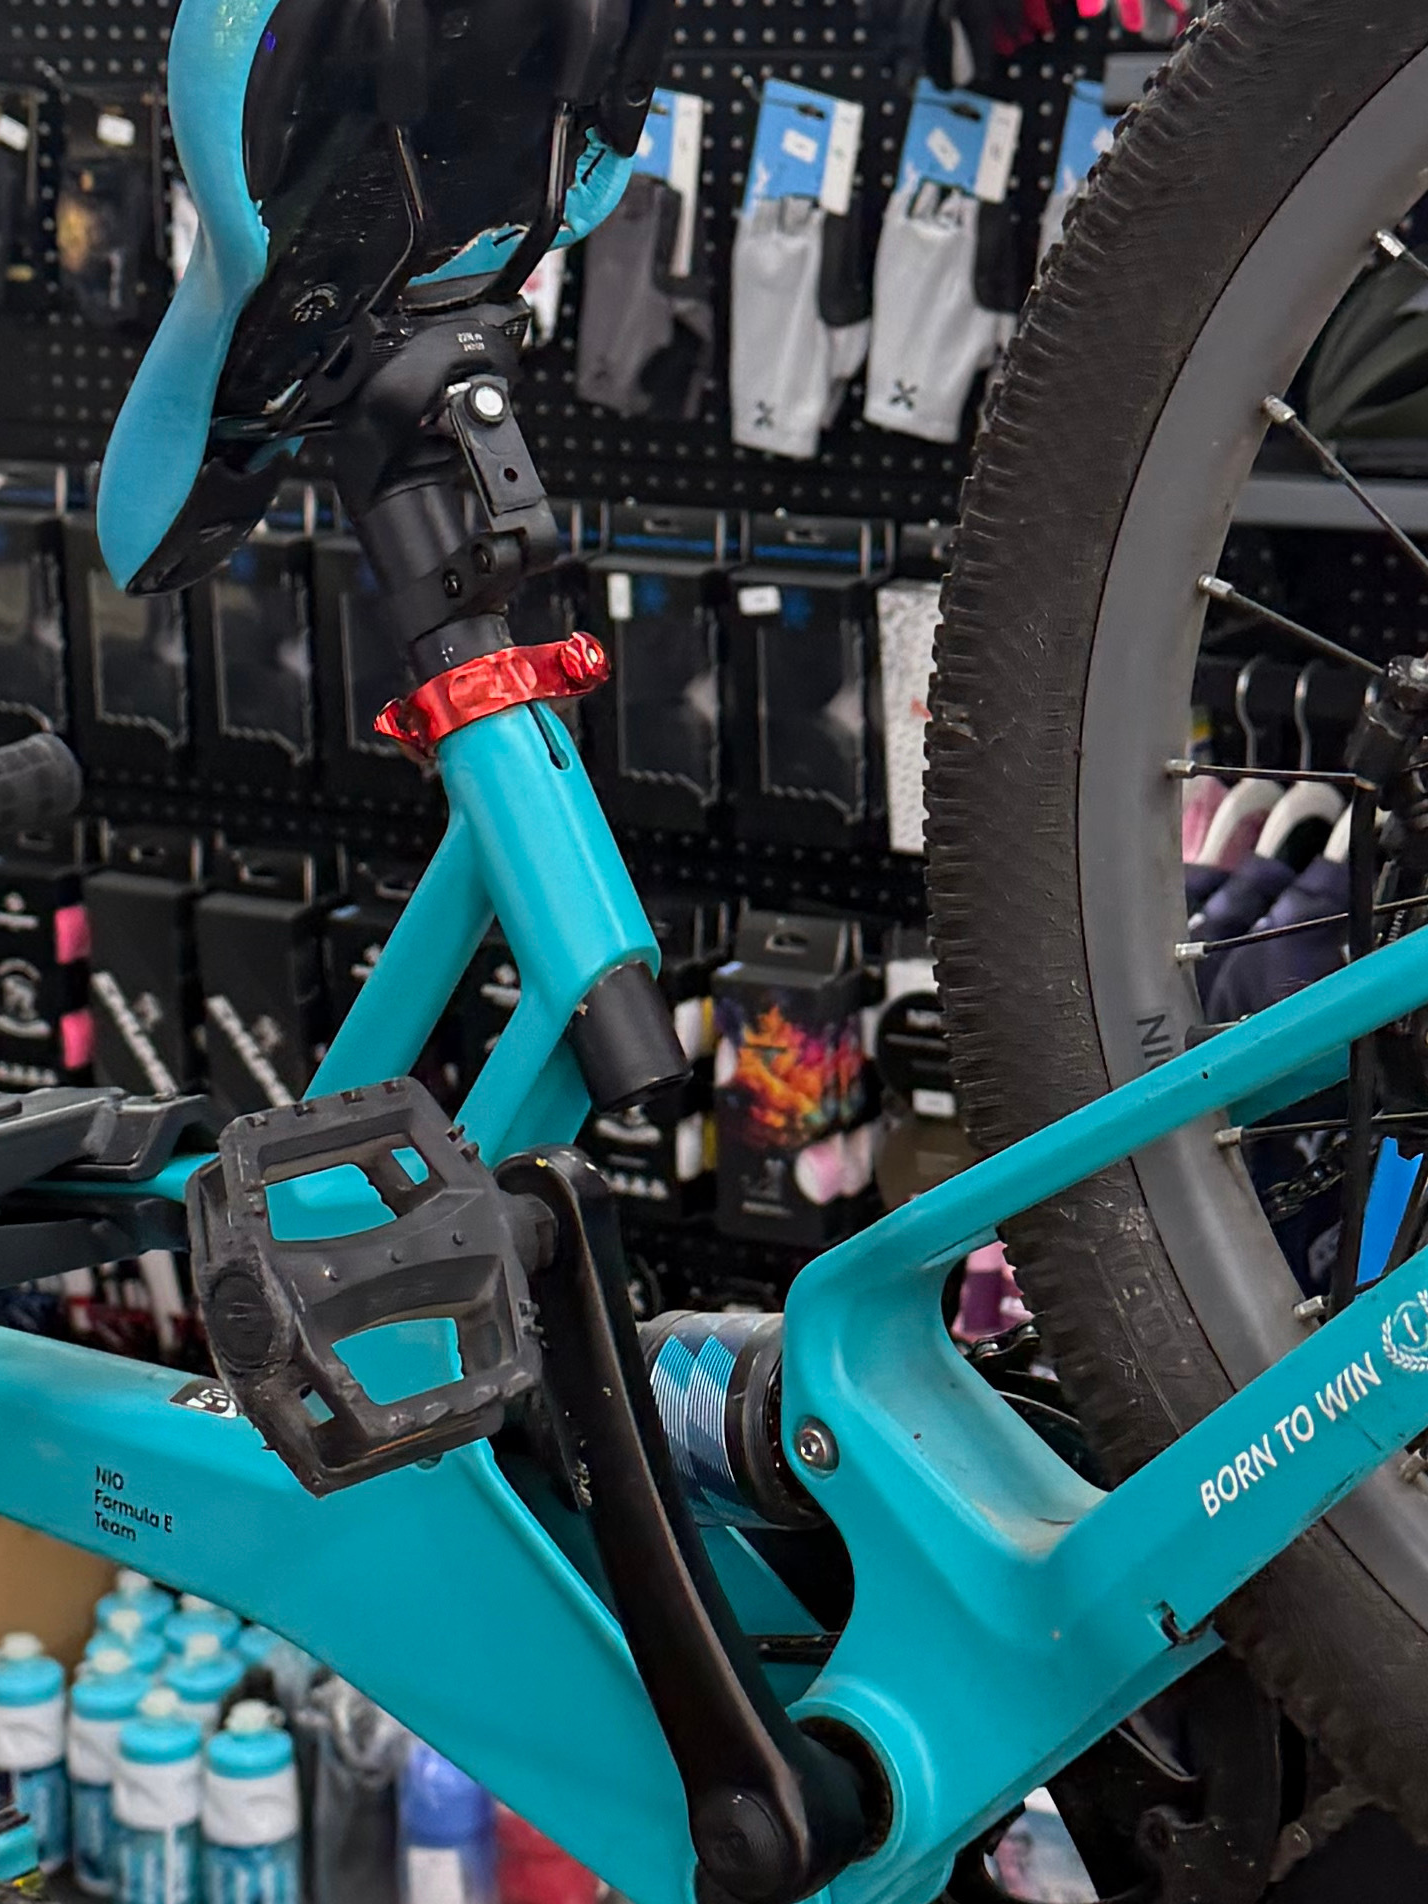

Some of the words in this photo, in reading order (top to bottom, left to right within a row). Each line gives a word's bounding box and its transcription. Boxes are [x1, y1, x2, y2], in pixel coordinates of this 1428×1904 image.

[1136, 1014, 1173, 1069] NI
[1200, 1433, 1278, 1518] BORN
[1274, 1404, 1315, 1454] TO
[1314, 1351, 1382, 1422] WIN
[95, 1464, 124, 1491] NIO
[94, 1488, 160, 1529] Formula
[164, 1513, 173, 1533] E
[94, 1509, 137, 1543] Team
